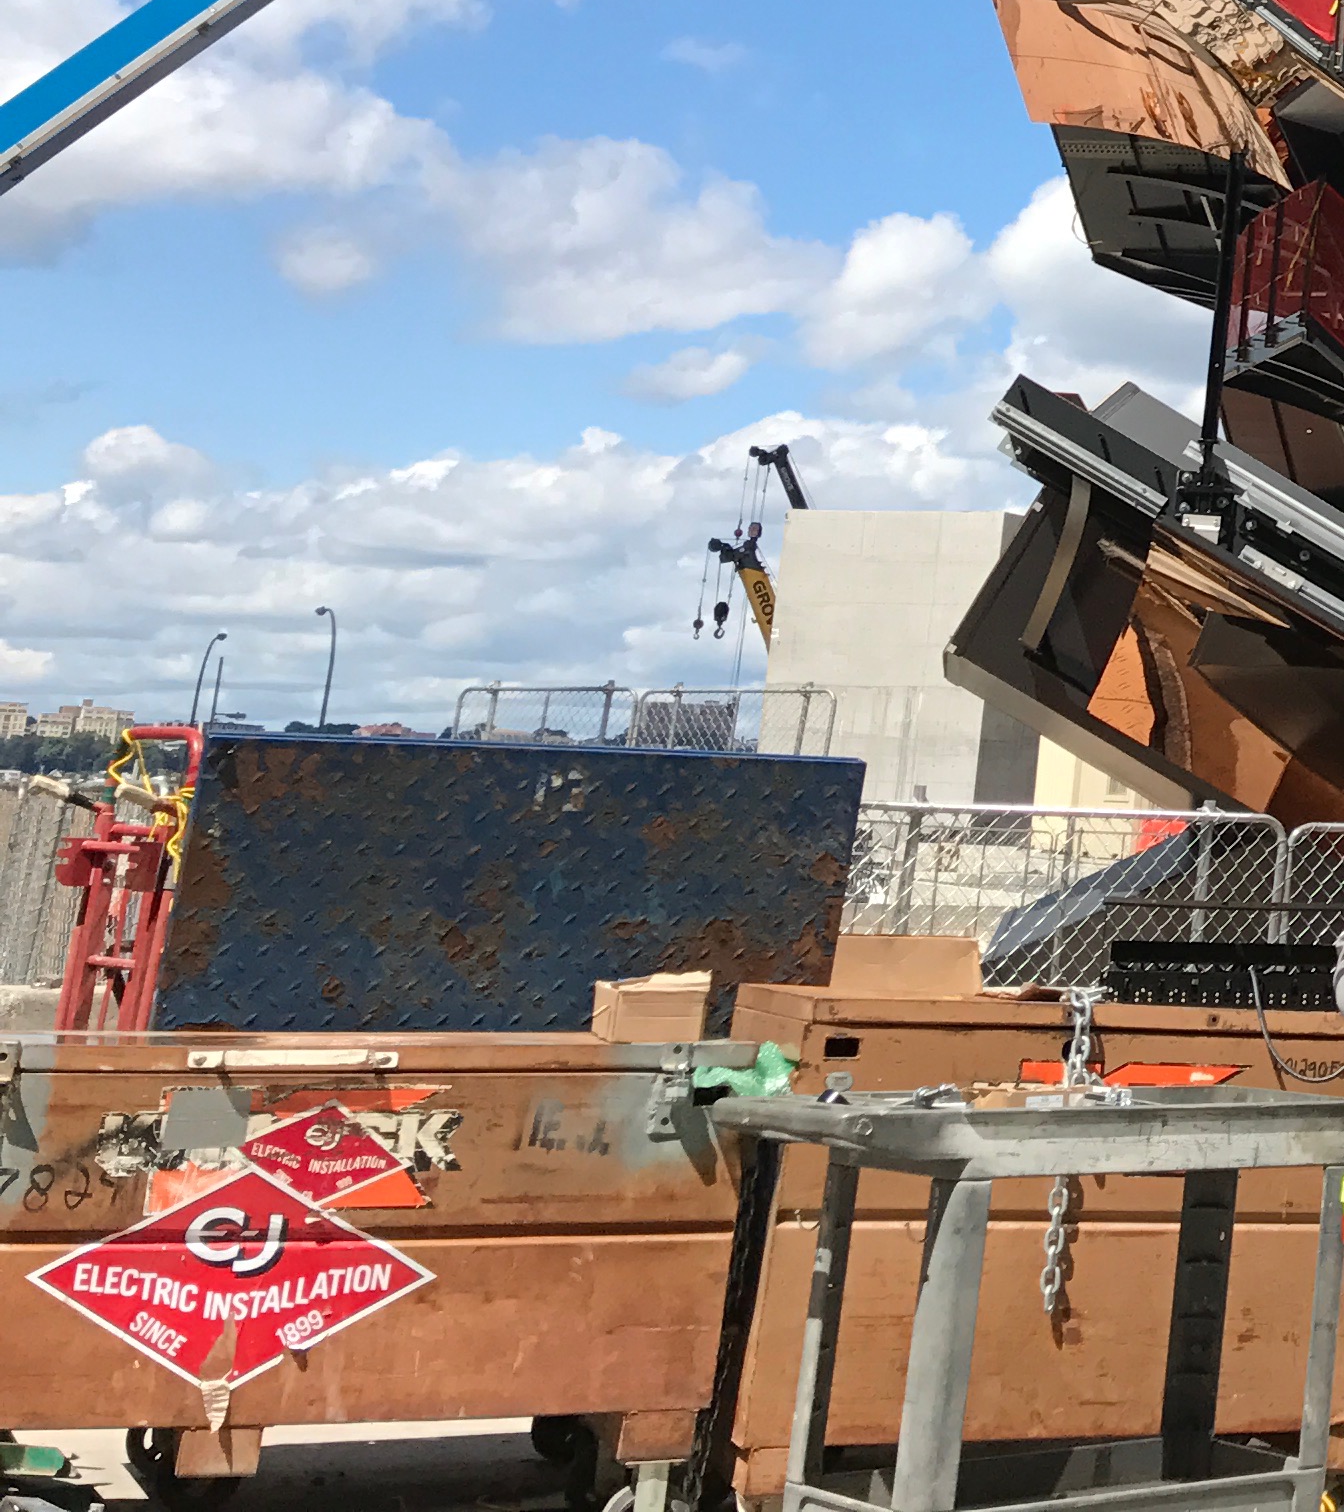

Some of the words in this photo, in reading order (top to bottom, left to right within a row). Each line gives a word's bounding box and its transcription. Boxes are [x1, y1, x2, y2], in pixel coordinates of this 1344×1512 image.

[307, 1154, 388, 1174] INSTALLATION
[73, 1262, 198, 1313] ELECTRIC
[202, 1264, 392, 1322] INSTALLATION
[128, 1311, 187, 1357] SINCE
[275, 1309, 325, 1349] 1899
